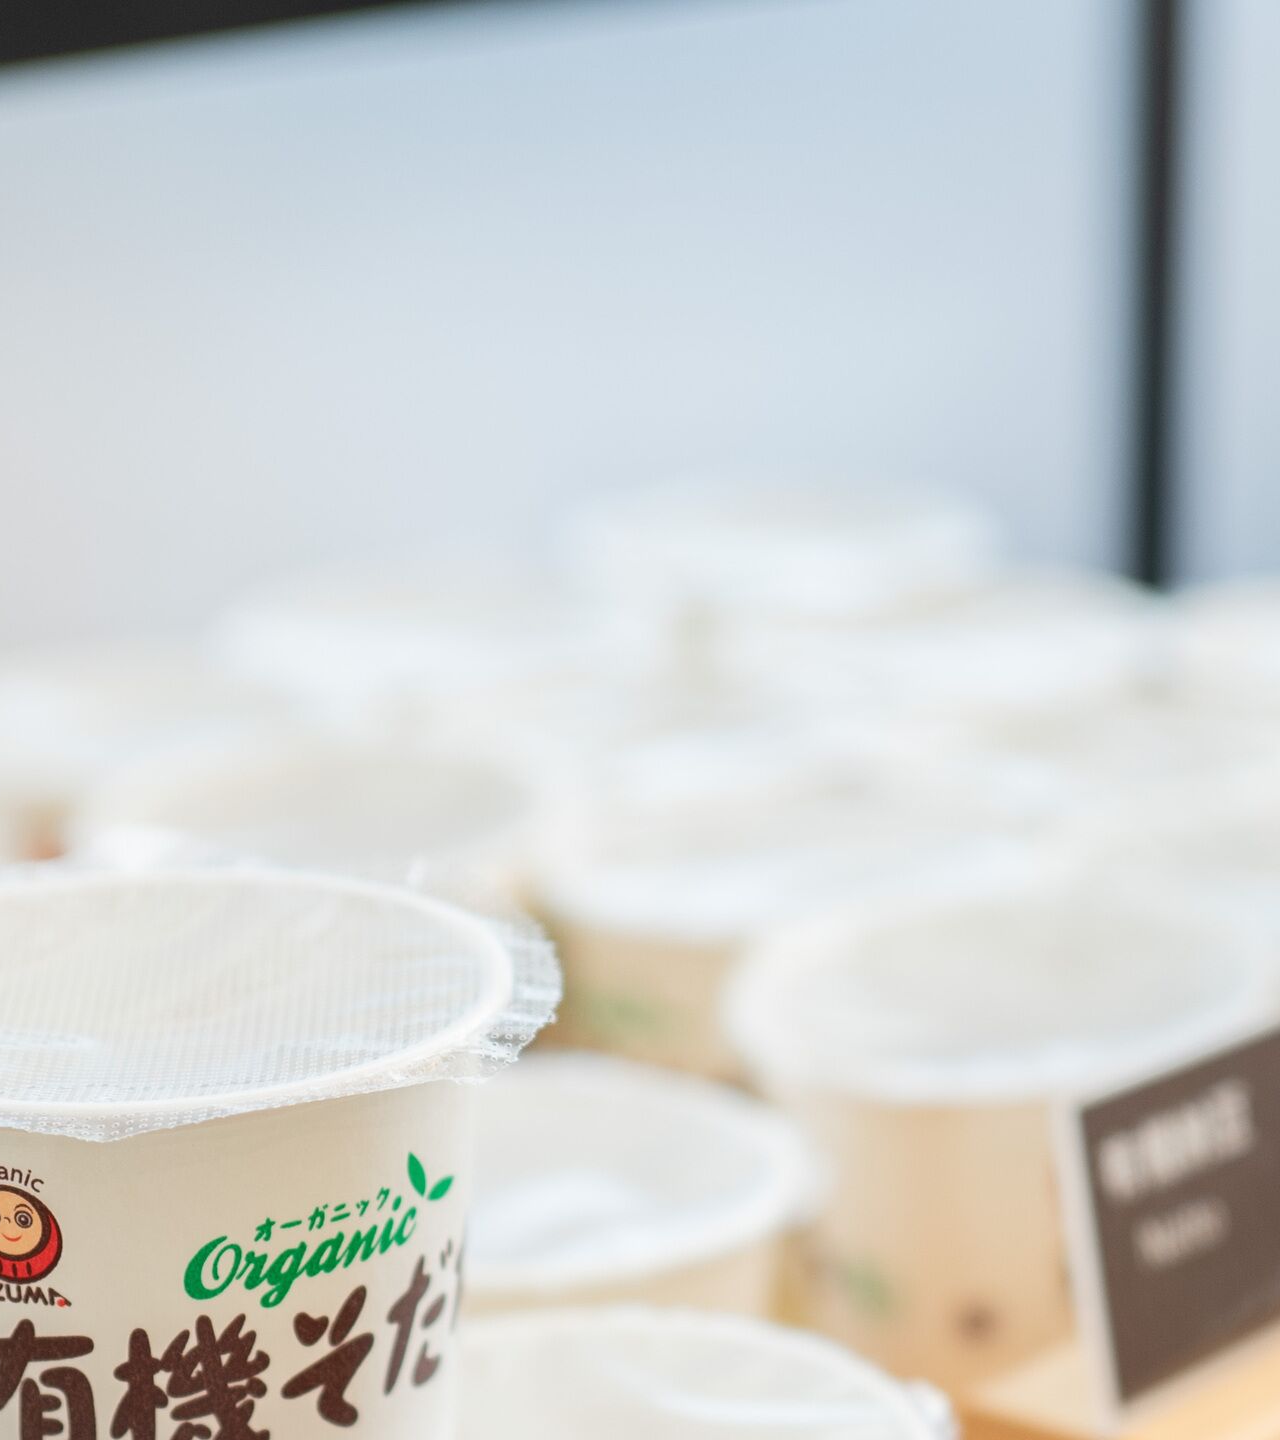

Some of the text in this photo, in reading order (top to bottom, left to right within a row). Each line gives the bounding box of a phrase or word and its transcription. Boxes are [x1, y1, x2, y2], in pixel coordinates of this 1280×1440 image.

[183, 1195, 417, 1308] Organic
[254, 1187, 390, 1242] オーガニック
